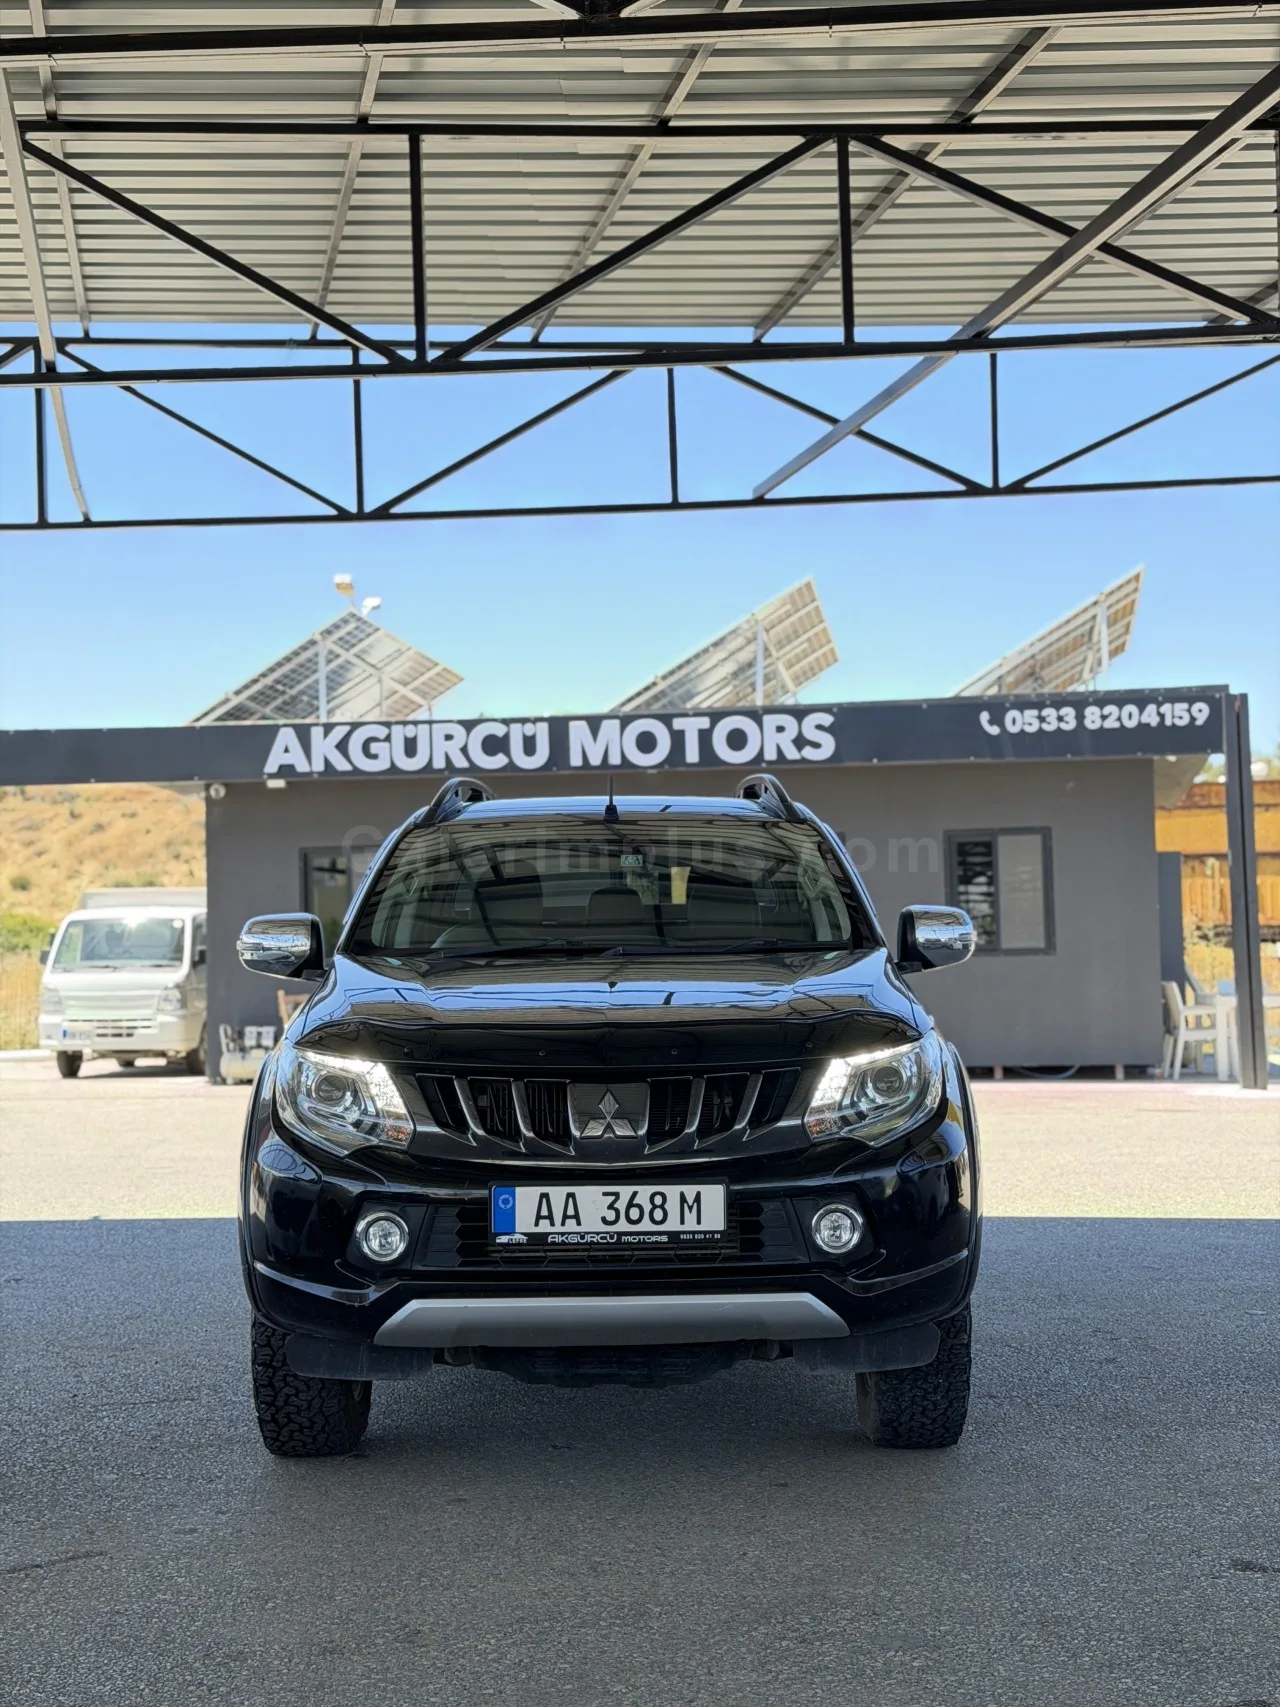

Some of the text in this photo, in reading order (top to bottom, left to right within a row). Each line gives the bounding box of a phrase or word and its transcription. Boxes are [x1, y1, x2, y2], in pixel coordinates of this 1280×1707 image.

[1004, 702, 1210, 734] 0533 8204159
[263, 712, 837, 774] AKGÜRCÜ MOTORS
[533, 1191, 582, 1227] AA
[600, 1190, 669, 1226] 368
[548, 1233, 618, 1243] AKGÜRCÜ
